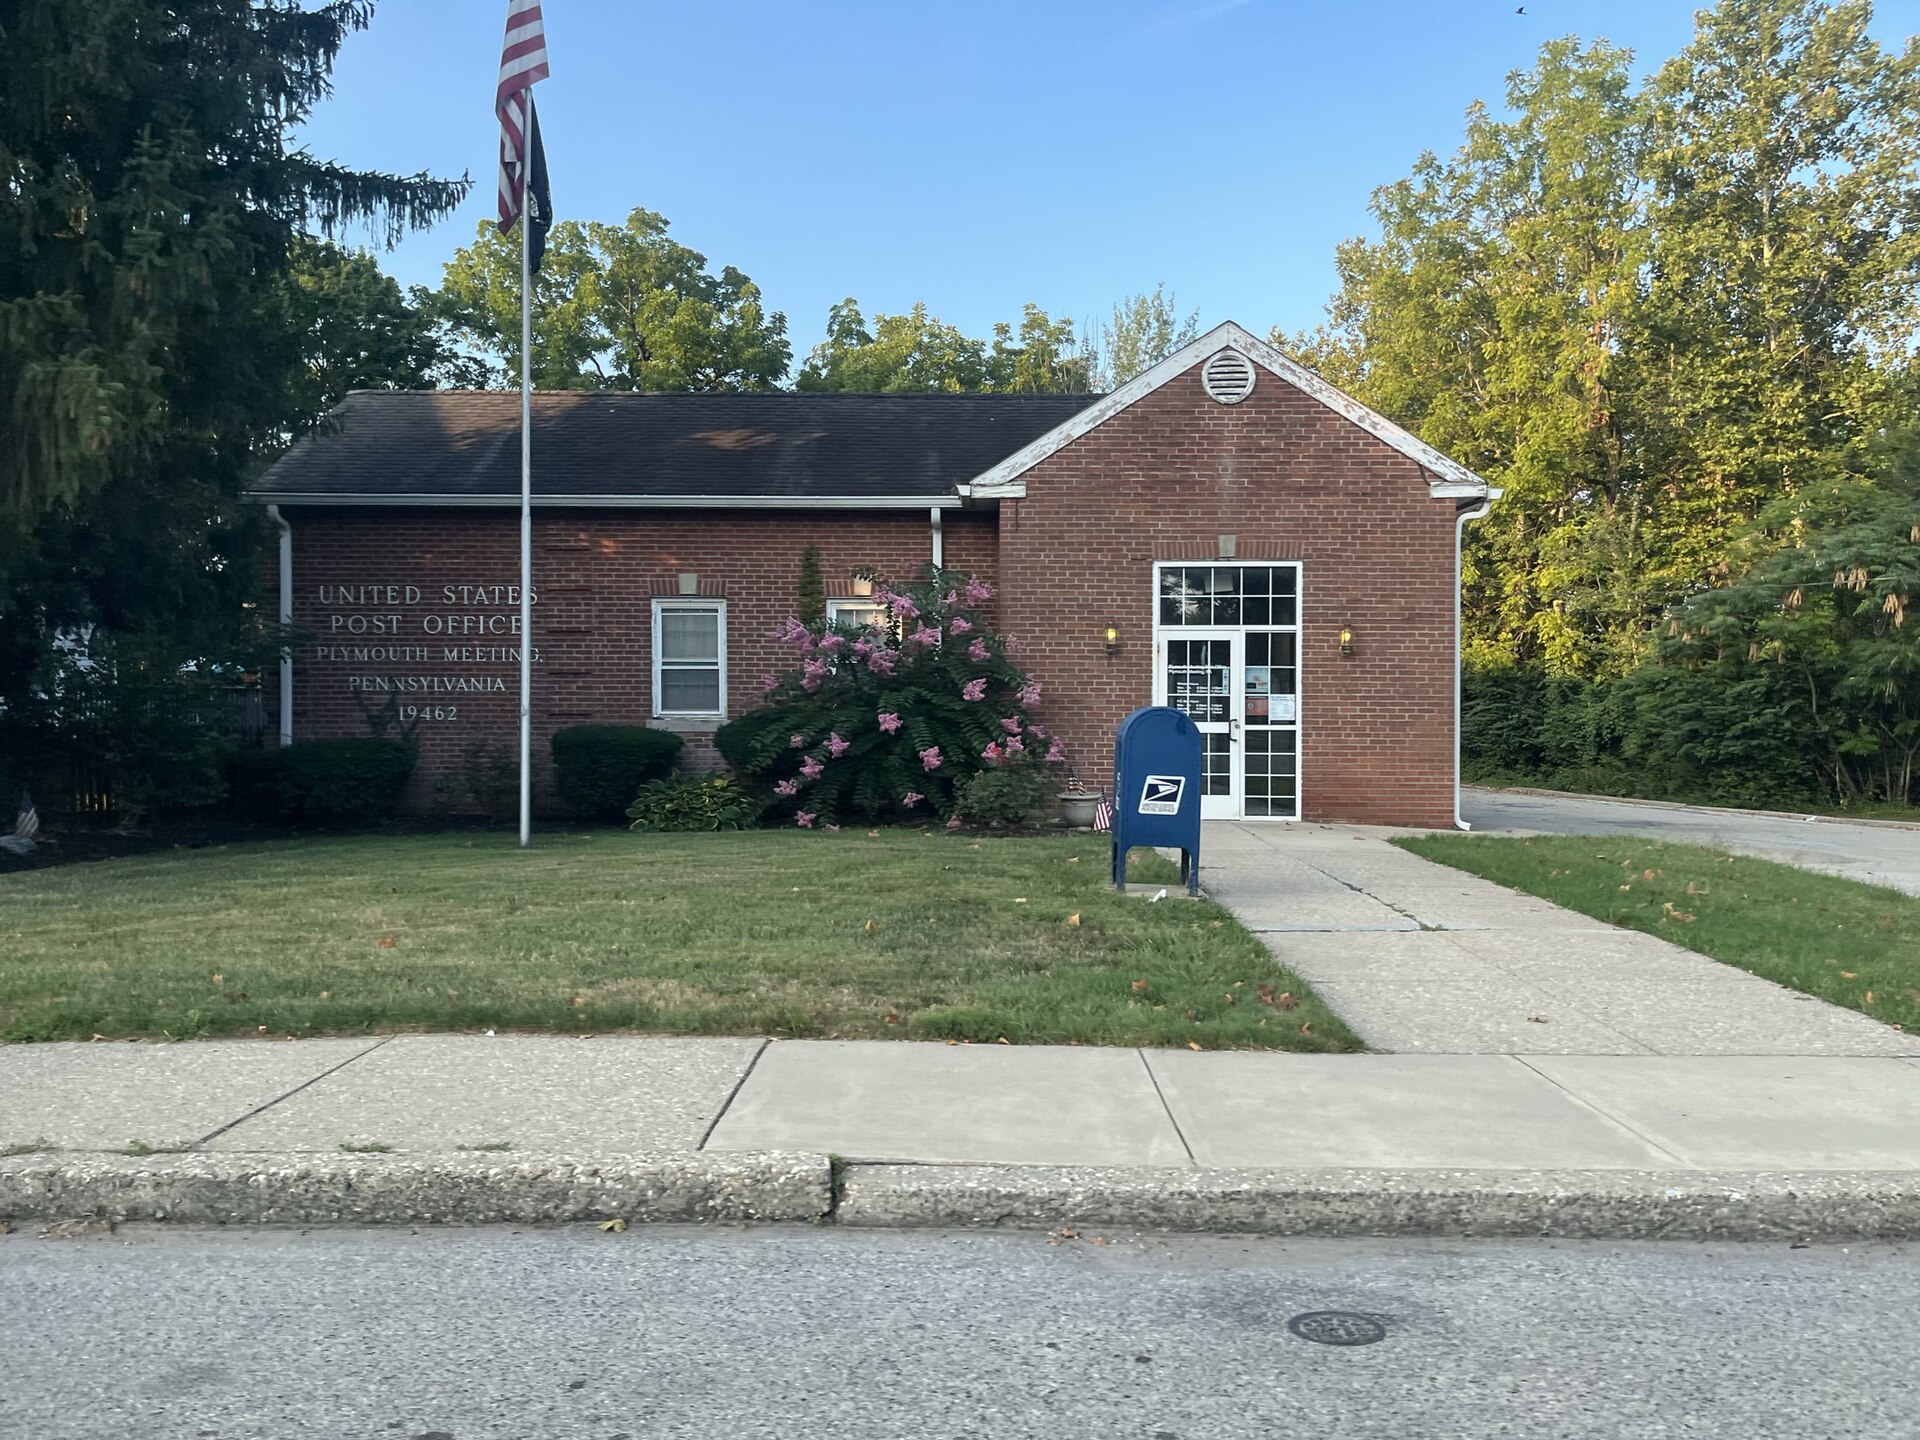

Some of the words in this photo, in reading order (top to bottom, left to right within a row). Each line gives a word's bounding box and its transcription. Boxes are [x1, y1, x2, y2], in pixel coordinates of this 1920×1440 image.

[319, 585, 421, 605] UNITED
[443, 585, 538, 605] STATES
[330, 614, 402, 635] POST
[423, 614, 522, 635] OFFICE
[316, 646, 428, 662] PLYMOUTH
[349, 676, 506, 692] PENNSYLVANIA
[399, 705, 457, 721] 19462
